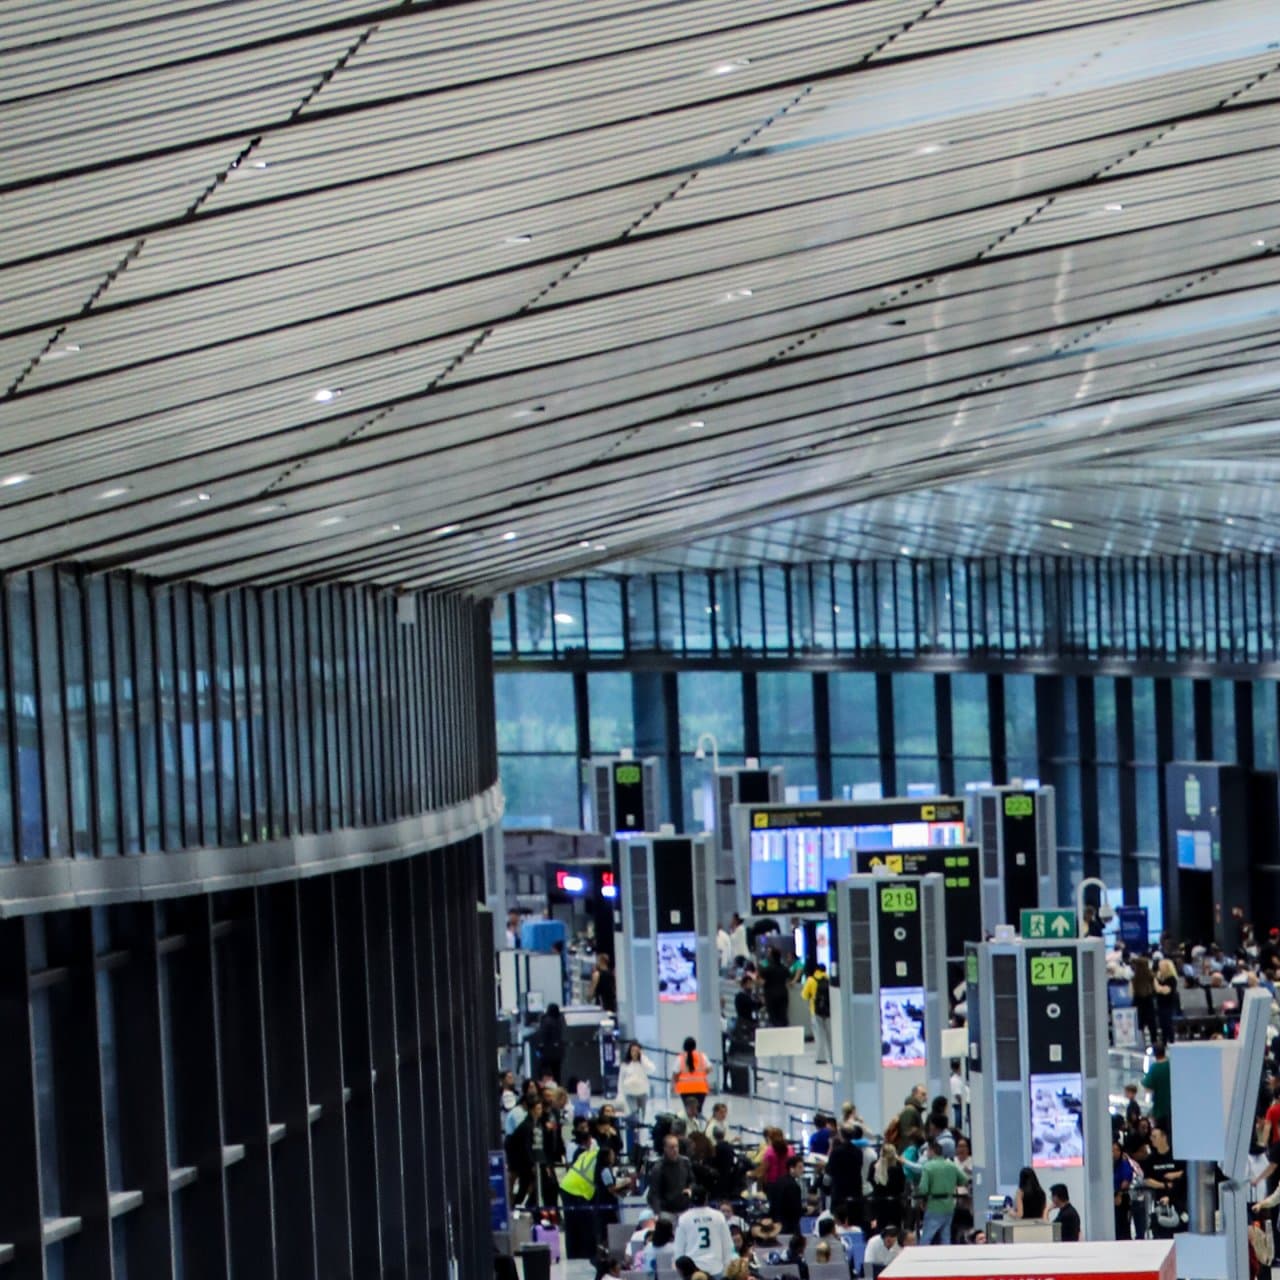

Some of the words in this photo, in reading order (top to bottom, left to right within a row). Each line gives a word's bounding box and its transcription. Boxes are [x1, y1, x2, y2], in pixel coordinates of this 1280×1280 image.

[883, 891, 915, 908] 218
[1034, 962, 1069, 980] 217
[698, 1226, 711, 1249] 3
